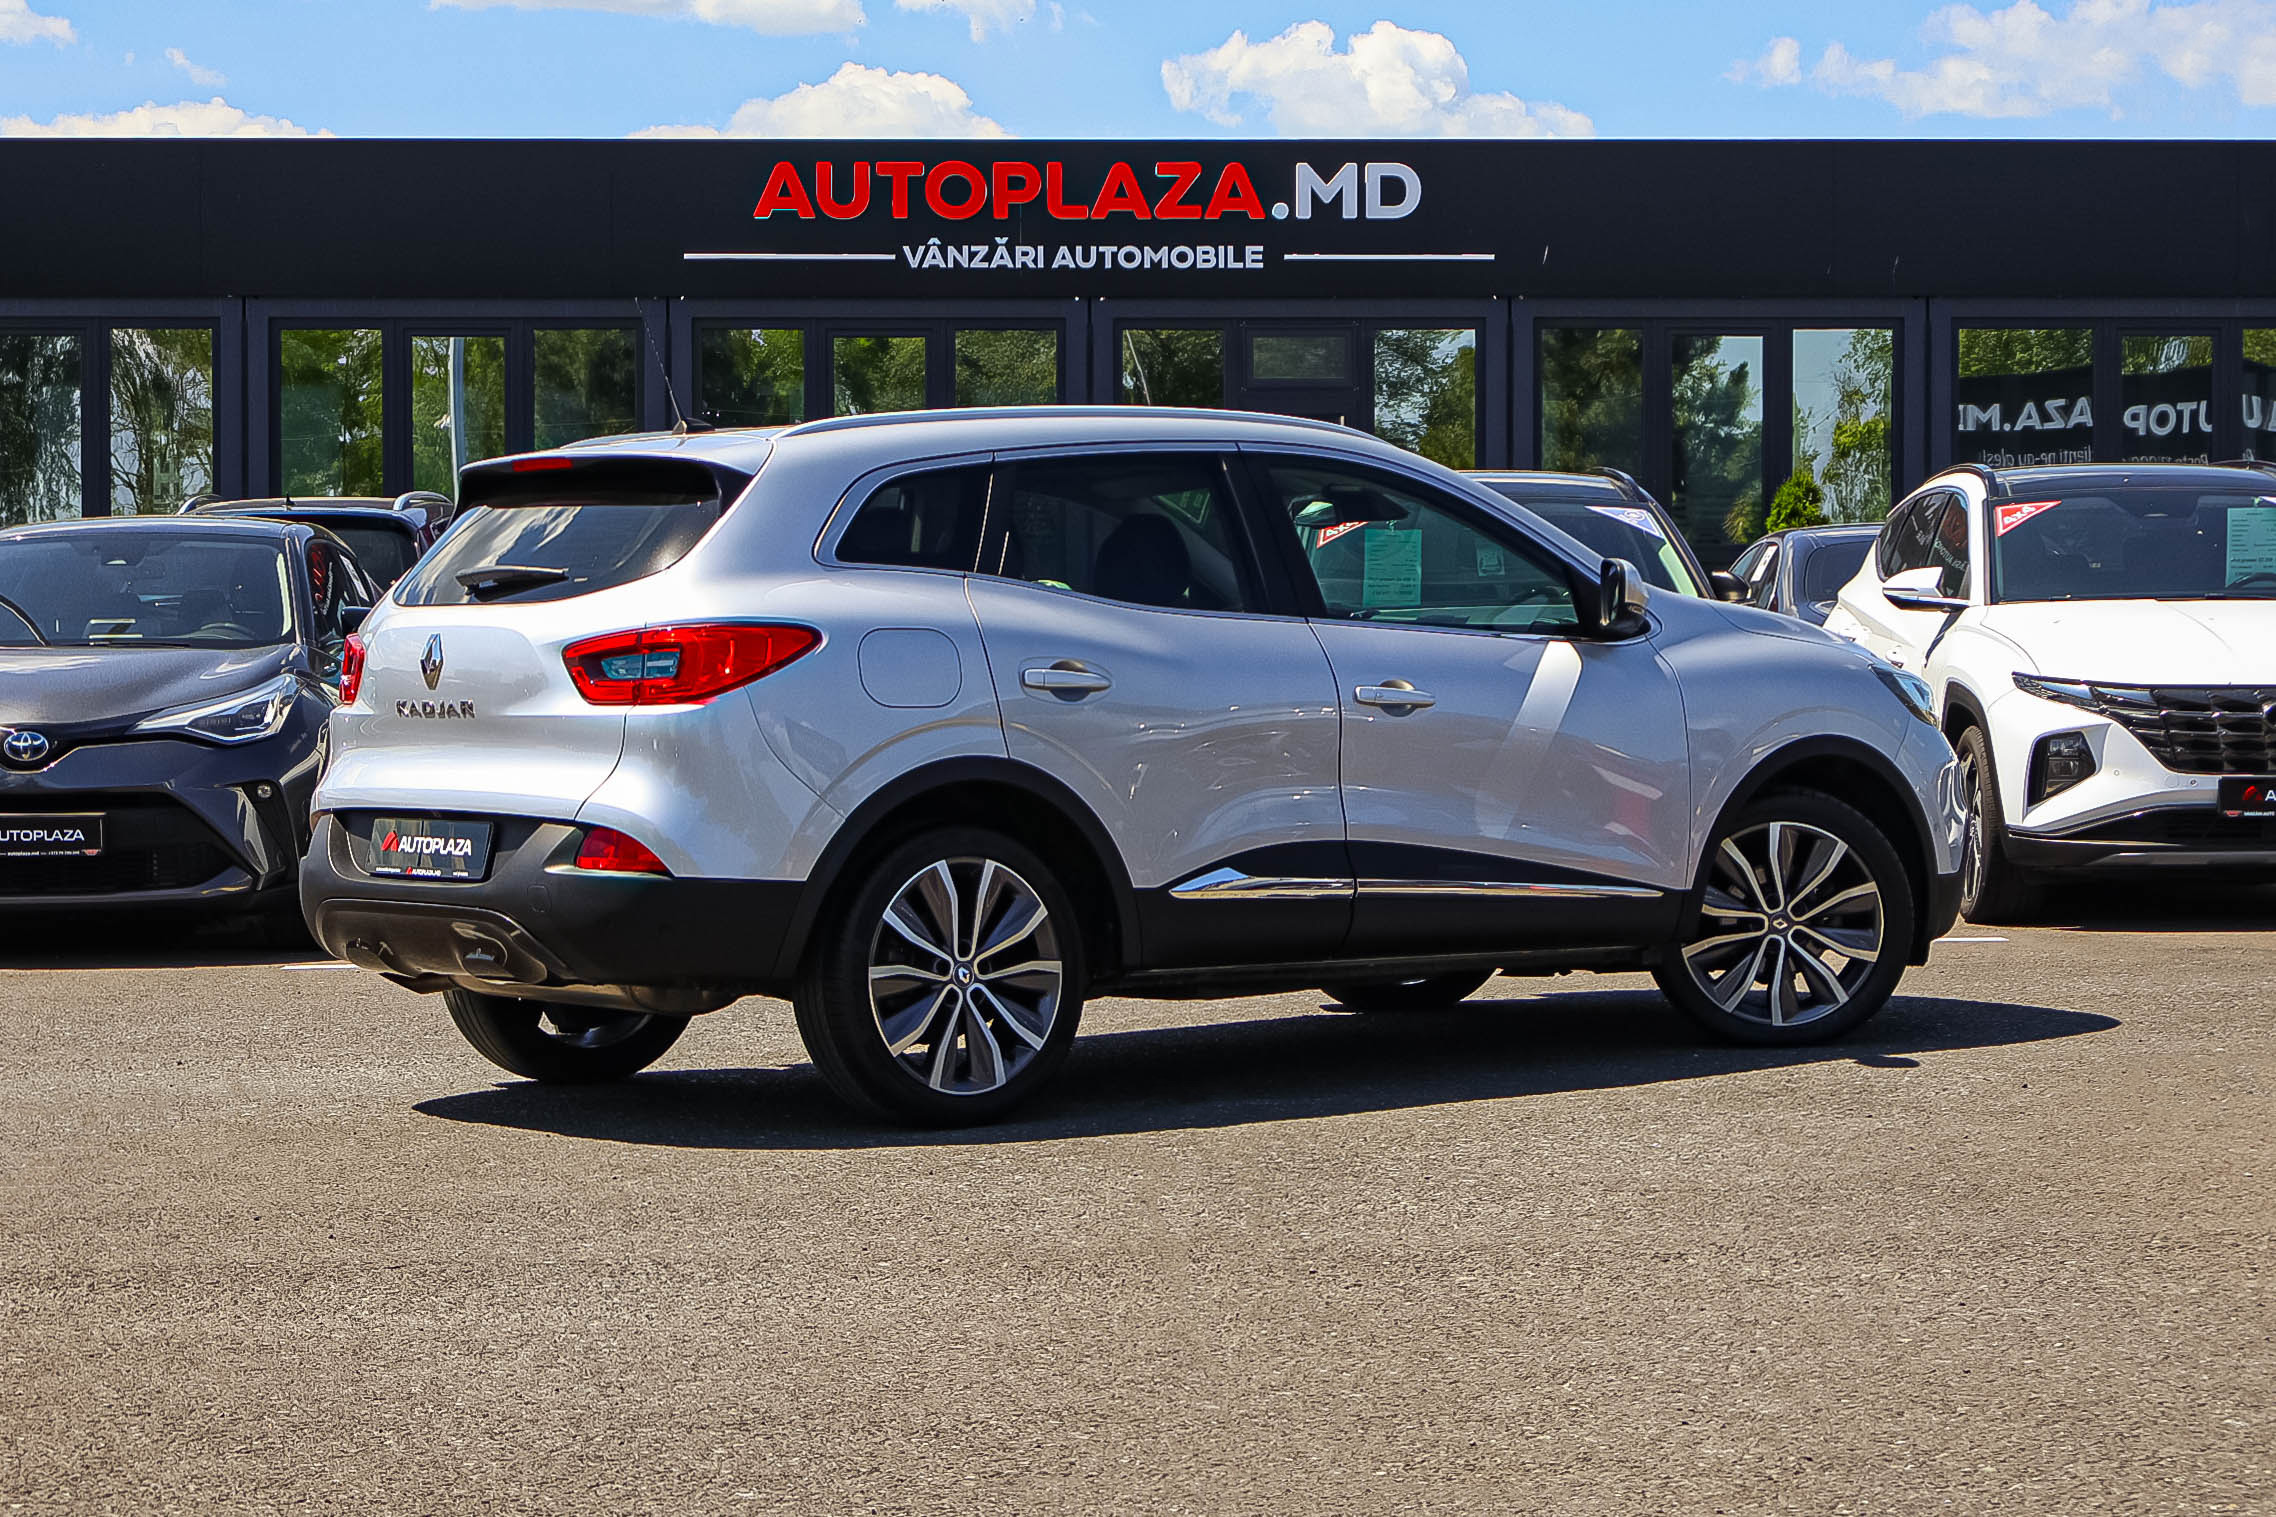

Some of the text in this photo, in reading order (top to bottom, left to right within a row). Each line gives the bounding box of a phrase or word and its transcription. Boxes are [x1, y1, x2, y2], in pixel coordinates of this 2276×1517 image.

[752, 160, 1421, 219] AUTOPLAZA.MD
[903, 236, 1264, 270] VÂNZĂRI AUTOMOBILE
[395, 699, 476, 719] KADJAR
[398, 835, 473, 856] AUTOPLAZA
